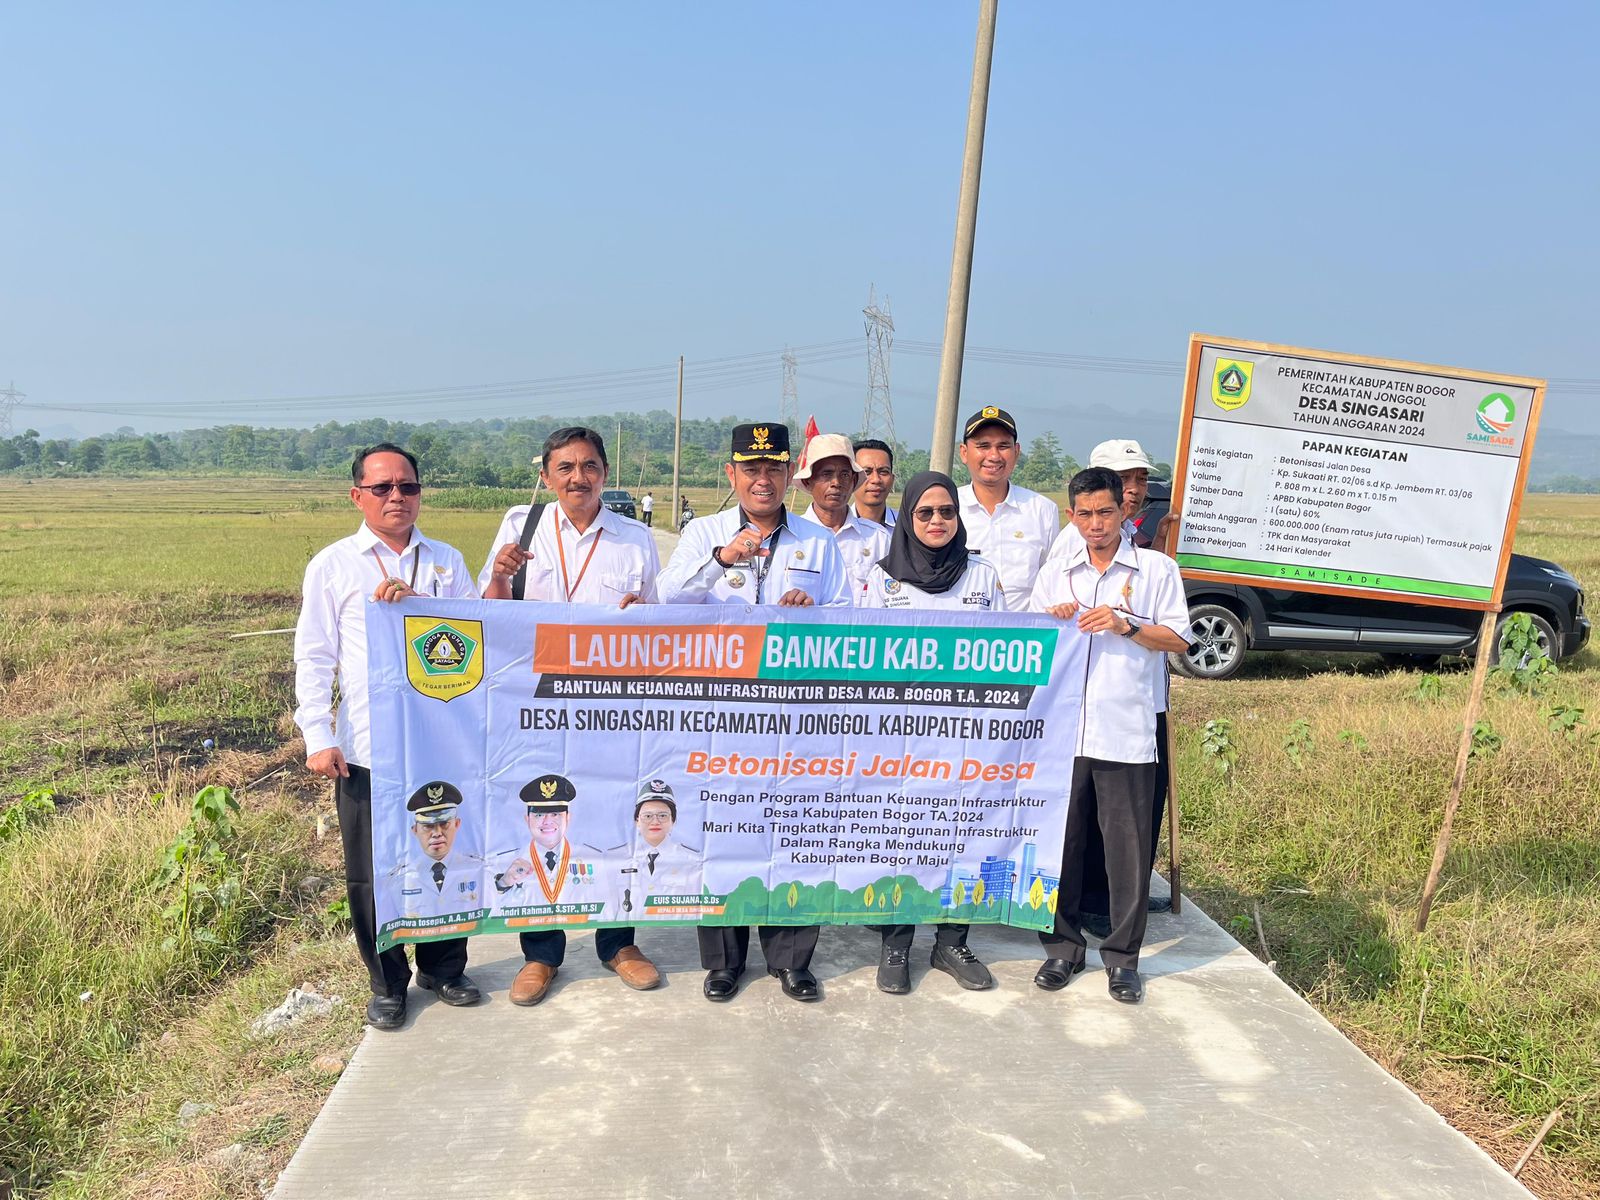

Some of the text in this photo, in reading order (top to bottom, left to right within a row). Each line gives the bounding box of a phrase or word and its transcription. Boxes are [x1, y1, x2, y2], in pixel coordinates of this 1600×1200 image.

[1278, 366, 1456, 398] PEMERINTAH KABUPATEN BOGOR
[1302, 383, 1427, 406] KECAMATAN JONGGOL
[1298, 396, 1424, 422] DESA SINGASARI
[1293, 412, 1425, 437] TAHUN ANGGARAN 2024
[1466, 432, 1514, 446] SAMISADE
[1194, 446, 1216, 456] Jenis
[1216, 449, 1253, 460] Kegiatan
[1280, 456, 1324, 468] Betonisasi
[1326, 463, 1348, 472] Jalan
[1350, 465, 1371, 474] Desa
[1302, 440, 1408, 462] PAPAN KEGIATAN
[1192, 472, 1221, 482] Volume
[1284, 482, 1300, 490] 808
[1327, 488, 1346, 496] 2.60
[1372, 492, 1386, 501] 0.15
[1193, 458, 1218, 468] Lokasi
[1277, 469, 1290, 478] Kp.
[1292, 470, 1326, 481] Sukaati
[1328, 475, 1340, 483] RT.
[1342, 476, 1364, 486] 02/06
[1380, 482, 1392, 490] Kp.
[1435, 488, 1446, 496] RT.
[1448, 489, 1472, 499] 03/06
[1189, 496, 1213, 508] Tahap
[1276, 506, 1300, 518] (satu)
[1303, 510, 1320, 518] 60%
[1190, 484, 1220, 494] Sumber
[1222, 488, 1243, 497] Dana
[1273, 494, 1295, 503] APBD
[1296, 497, 1344, 508] Kabupaten
[1346, 503, 1372, 514] Bogor
[1186, 522, 1226, 534] Pelaksana
[1268, 532, 1282, 540] TPK
[1301, 536, 1350, 547] Masyarakat
[1187, 510, 1216, 520] Jumlah
[1218, 514, 1257, 524] Anggaran
[1270, 519, 1320, 531] 600.000.000
[1322, 524, 1350, 534] (Enam
[1351, 528, 1373, 538] ratus
[1374, 530, 1392, 540] juta
[1394, 534, 1424, 544] rupiah)
[1426, 537, 1468, 549] Termasuk
[1469, 542, 1492, 552] pajak
[1184, 535, 1206, 543] Lama
[1206, 538, 1246, 548] Pekerjaan
[1276, 545, 1293, 553] Hari
[1294, 548, 1331, 557] Kalender
[570, 634, 1042, 674] LAUNCHING BANKEU KAB. BOGOR
[444, 680, 470, 689] BERIMAN
[554, 680, 1020, 704] BANTUAN KEUANGAN INFRASTRUKTUR DESA KAB. BOGOR T.A. 2024
[520, 708, 1044, 740] DESA SINGASARI KECAMATAN JONGGOL KABUPATEN BOGOR
[686, 752, 1036, 782] Betonisasi Jalan Desa
[700, 790, 1046, 808] Dengan Program Bantuan Keuangan Infrastruktur
[764, 808, 984, 822] Desa Kabupaten Bogor TA.2024
[702, 822, 1038, 838] Mari Kita Tingkatkan Pembangunan Infrastruktur
[780, 838, 965, 853] Dalam Rangka Mendukung
[791, 852, 950, 867] Kabupaten Bogor Maju
[654, 896, 670, 904] EUIS
[386, 920, 416, 932] Asmawa
